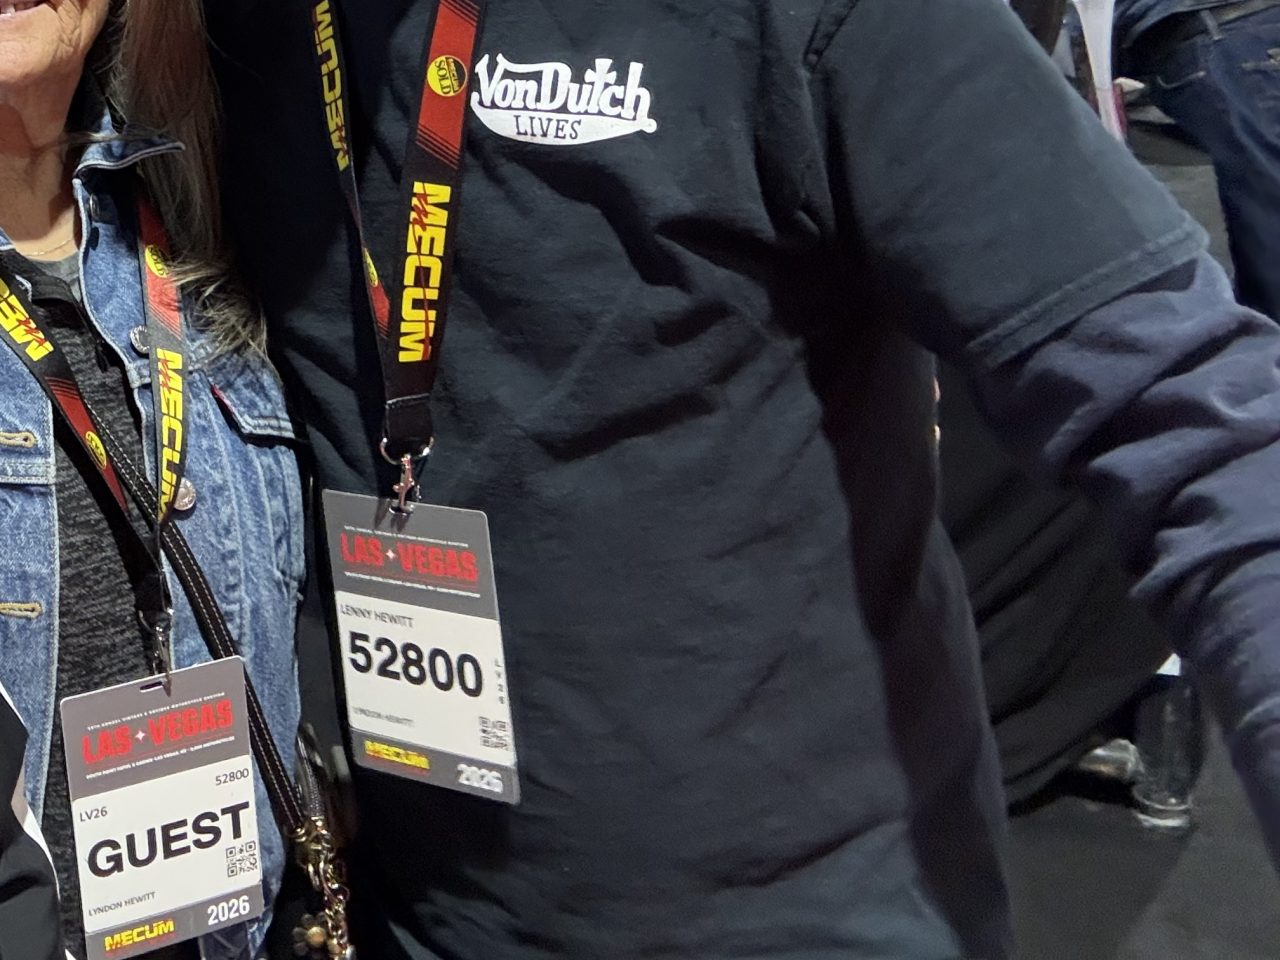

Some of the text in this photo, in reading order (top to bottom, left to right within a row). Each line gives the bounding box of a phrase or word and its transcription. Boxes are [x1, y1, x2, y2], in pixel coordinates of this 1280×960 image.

[314, 0, 350, 171] MECUM
[435, 60, 451, 94] SOLD
[513, 114, 582, 140] LIVES
[399, 181, 451, 362] MECUM
[340, 531, 385, 567] LAS
[396, 541, 479, 582] VEGAS
[341, 603, 414, 627] LENNY HEWITT
[348, 630, 483, 697] 52800
[81, 724, 133, 764] LAS
[147, 697, 235, 747] VEGAS
[215, 767, 250, 787] 52800
[79, 806, 108, 822] LV26
[87, 801, 250, 878] GUEST
[88, 891, 156, 917] LYNDON HEWITT
[207, 894, 251, 926] 2026
[103, 918, 175, 951] MECUM
